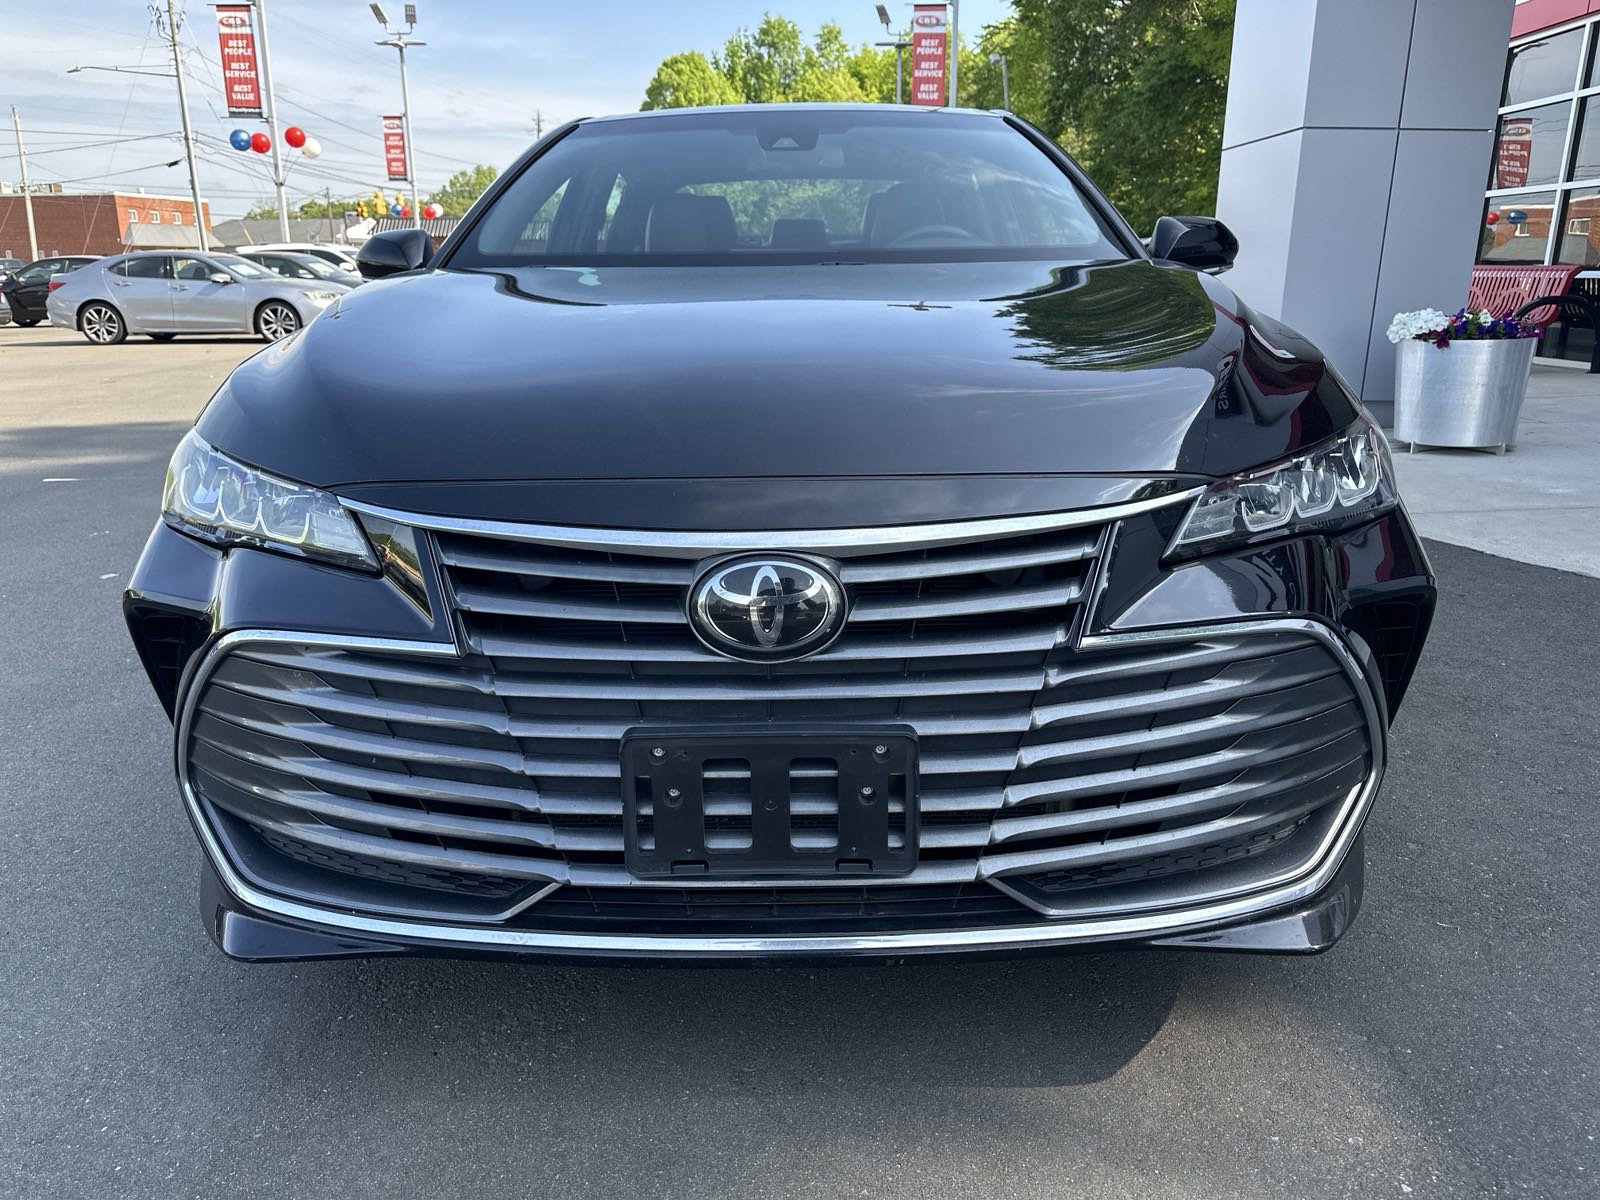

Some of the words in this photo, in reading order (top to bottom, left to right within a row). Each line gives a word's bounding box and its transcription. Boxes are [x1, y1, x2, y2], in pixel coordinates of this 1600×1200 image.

[224, 47, 252, 55] PEOPLE
[916, 47, 944, 55] PEOPLE
[231, 62, 249, 70] BEST
[920, 61, 939, 69] BEST
[225, 70, 256, 78] SERVICE
[233, 84, 252, 92] BEST
[232, 93, 255, 101] VALUE
[917, 92, 939, 100] VALUE
